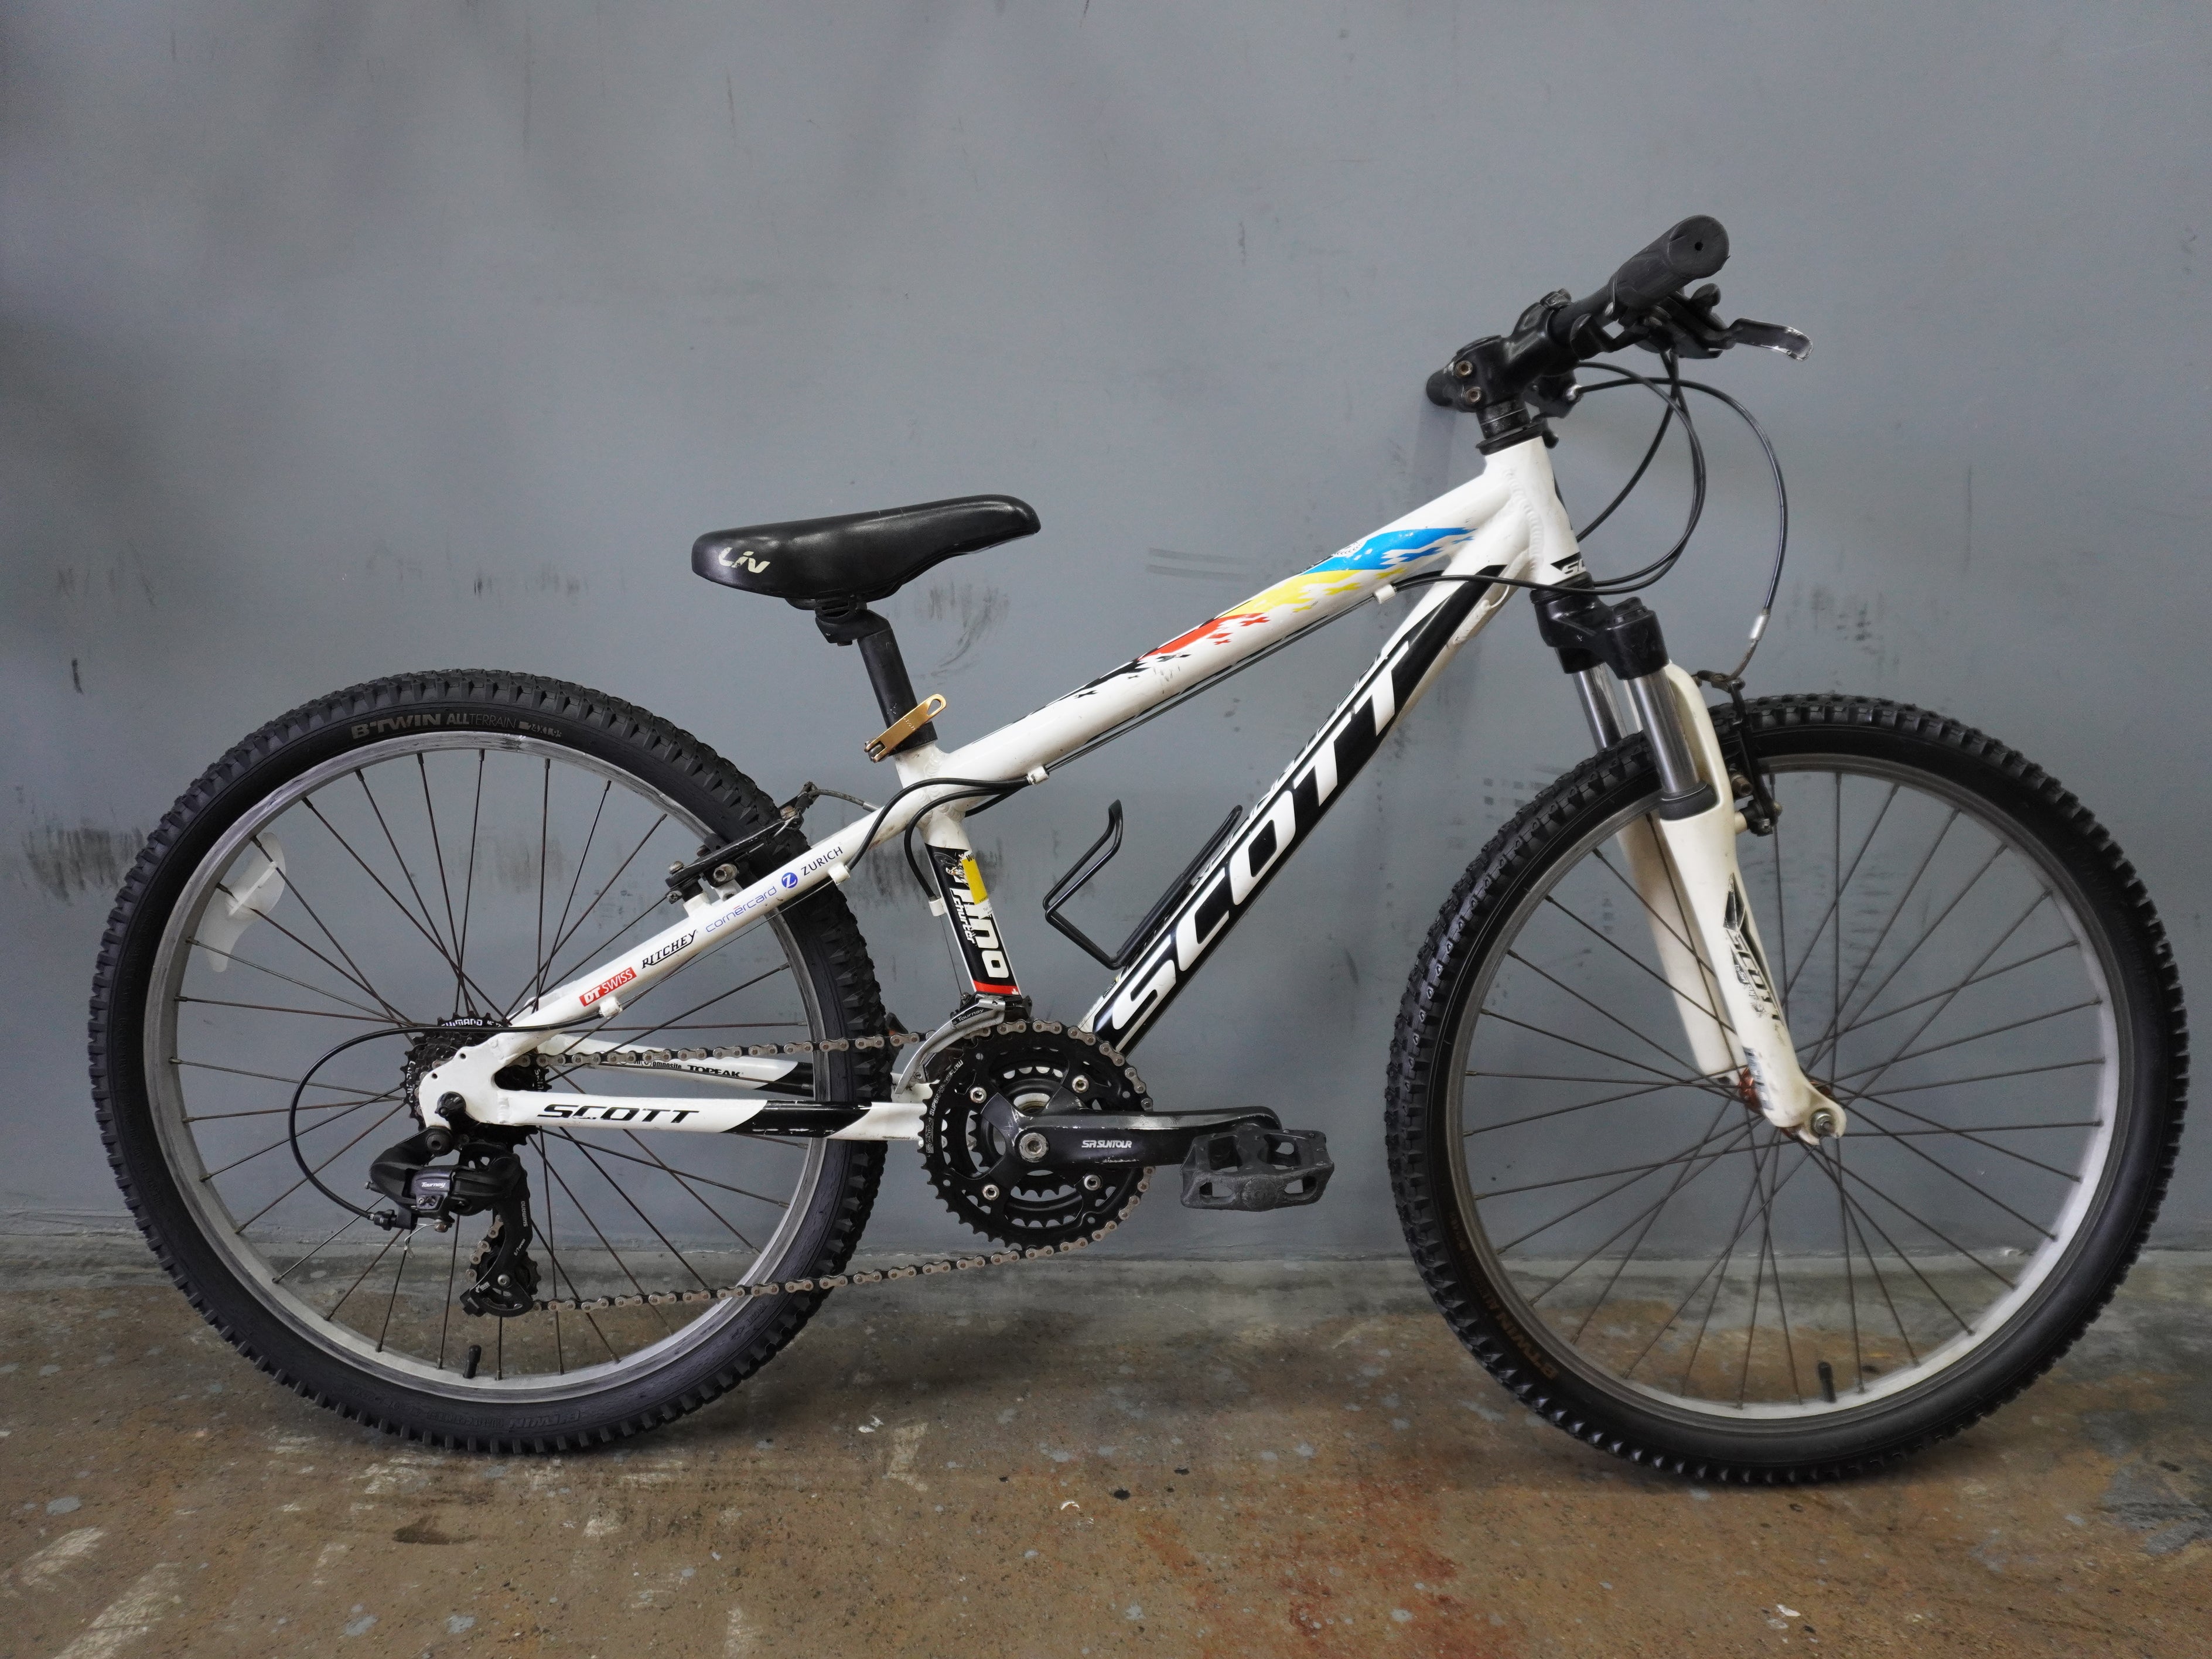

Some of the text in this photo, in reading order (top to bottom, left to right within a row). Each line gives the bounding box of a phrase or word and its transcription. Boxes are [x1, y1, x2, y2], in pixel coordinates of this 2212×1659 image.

[718, 546, 770, 574] Liv
[351, 713, 441, 740] B'TWIN
[801, 845, 844, 876] ZURICH
[1112, 640, 1409, 1053] SCOTT
[642, 929, 697, 970] RITCHEY
[583, 968, 634, 1005] DT SWISS
[441, 1018, 483, 1027] HIMANO
[687, 1064, 740, 1077] TOPEAK
[537, 1104, 699, 1124] SCOTT
